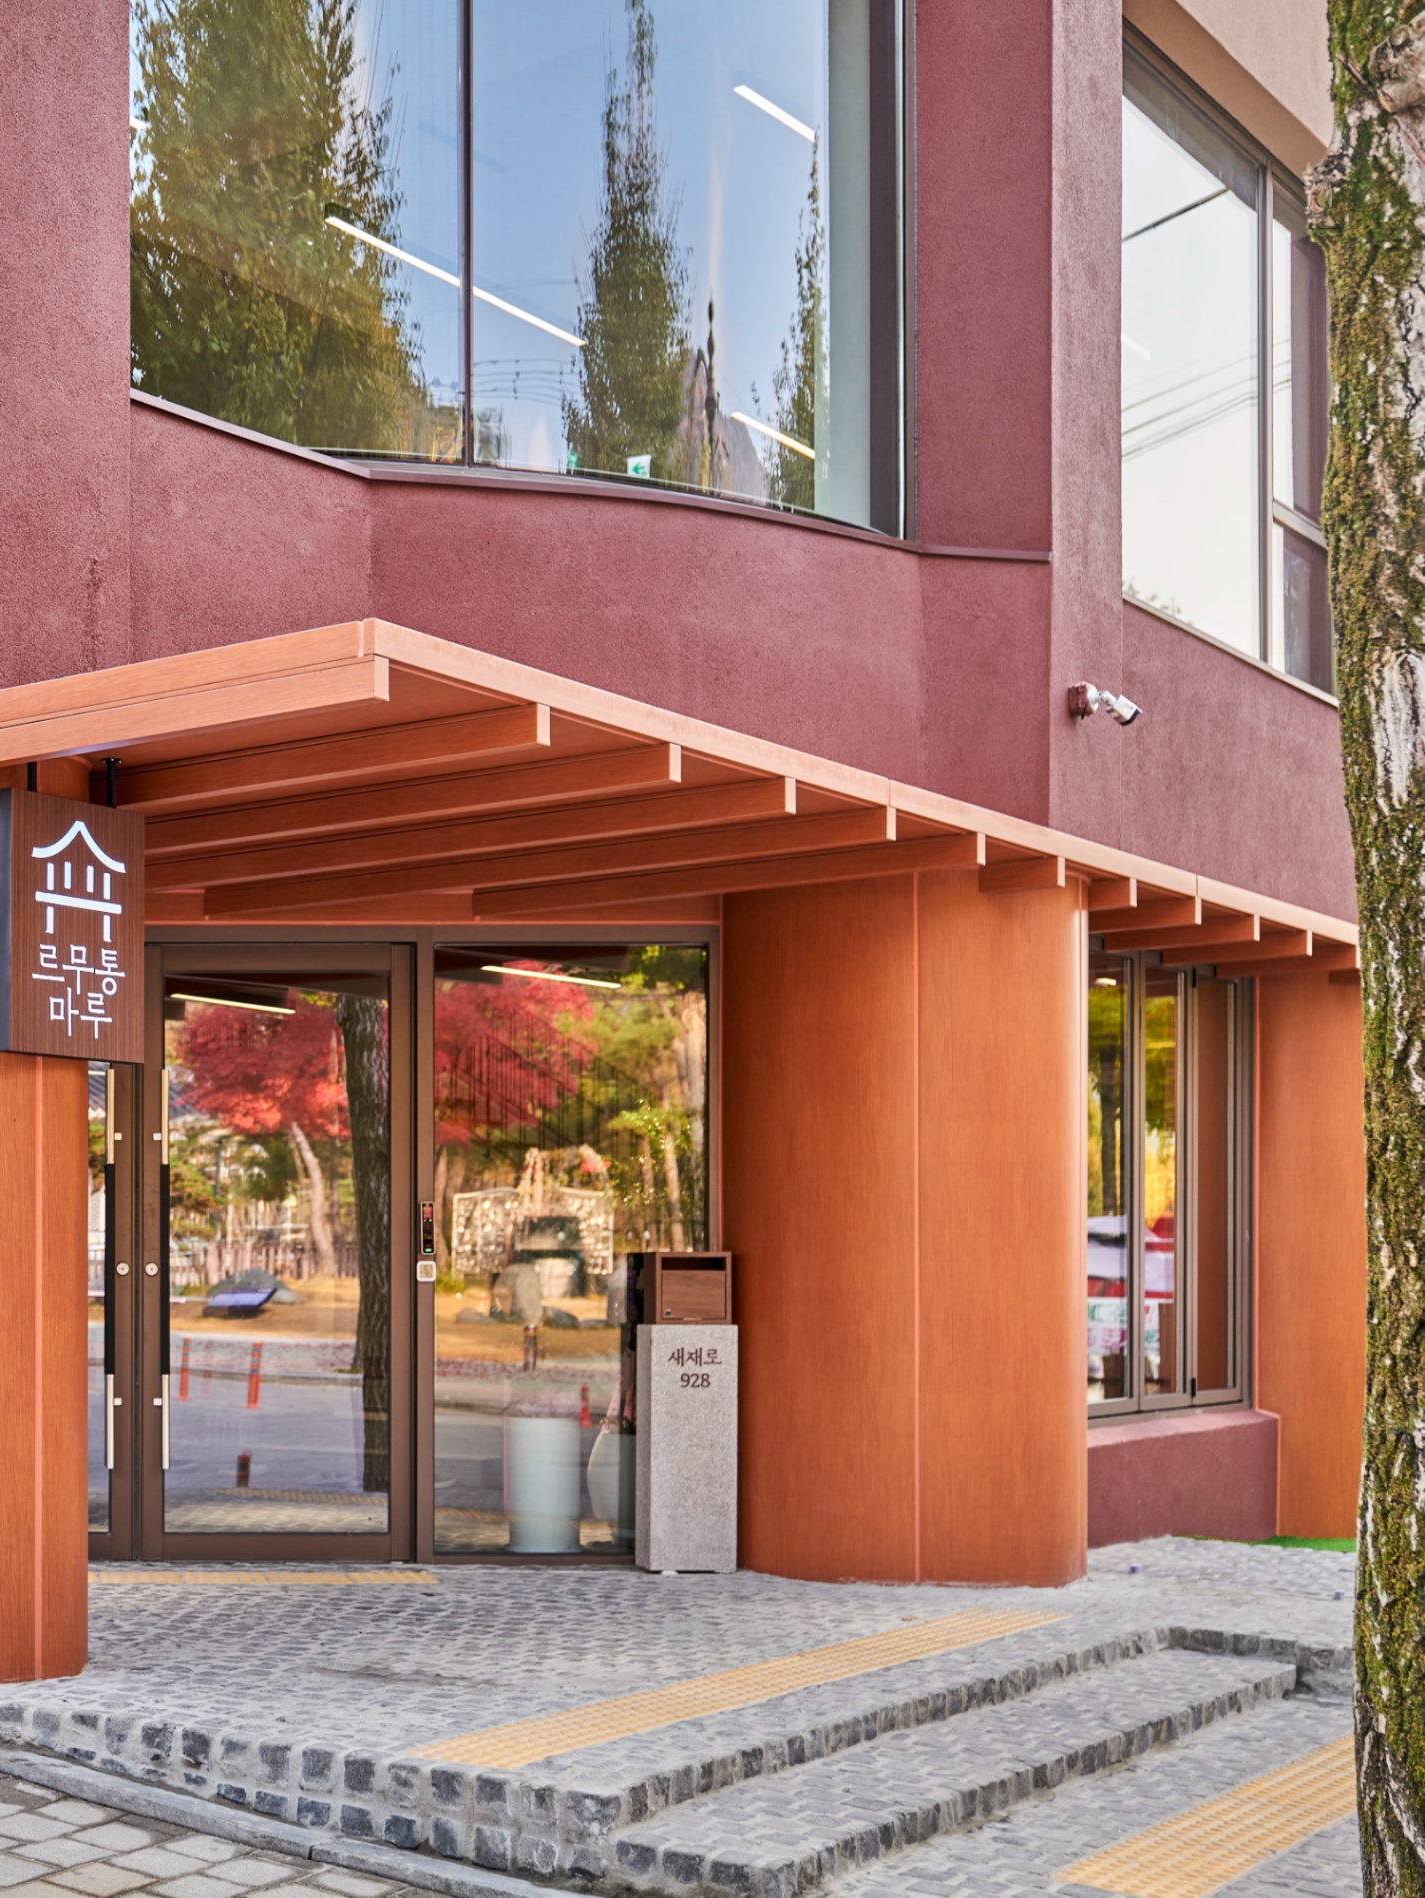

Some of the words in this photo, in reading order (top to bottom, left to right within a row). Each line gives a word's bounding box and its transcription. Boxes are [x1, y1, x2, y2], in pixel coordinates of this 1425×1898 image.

[32, 943, 126, 996] 르무통
[49, 986, 112, 1039] 마루
[667, 1346, 723, 1367] 새재로
[680, 1373, 711, 1388] 928
